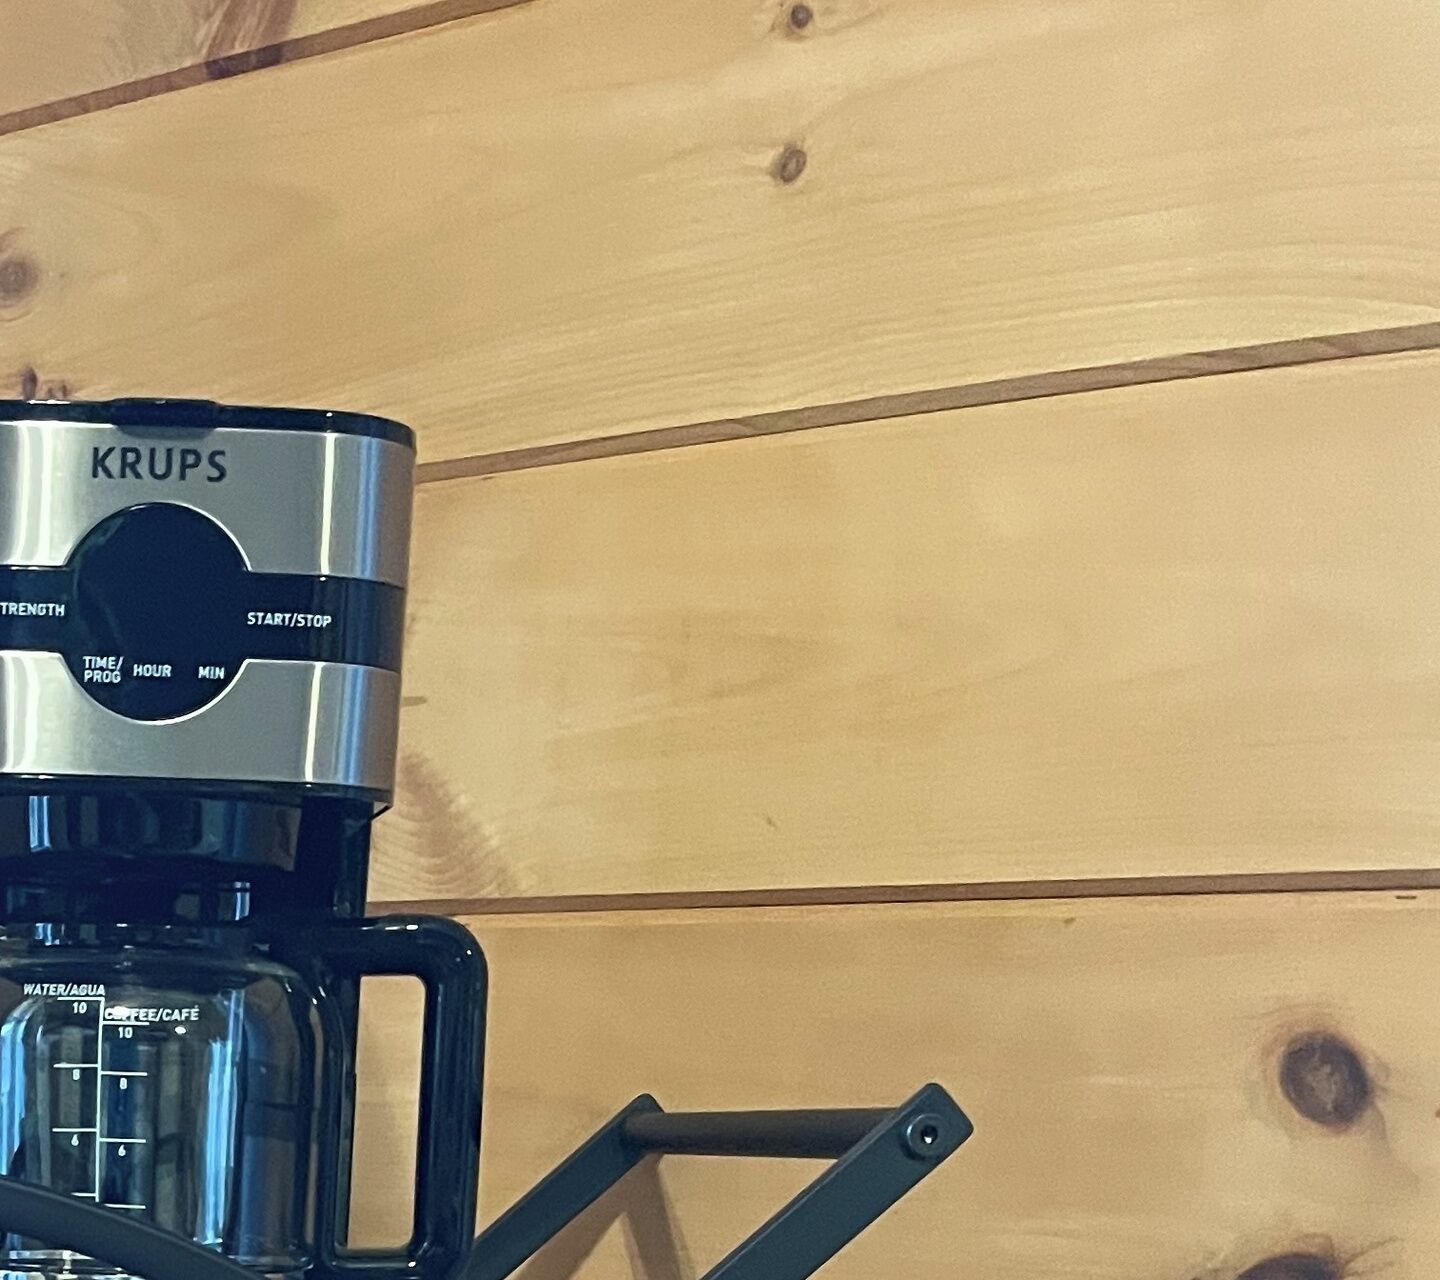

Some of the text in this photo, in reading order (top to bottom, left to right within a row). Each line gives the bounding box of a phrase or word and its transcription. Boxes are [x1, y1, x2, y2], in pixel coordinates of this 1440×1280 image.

[92, 446, 227, 482] KRUPS
[247, 612, 332, 628] START/STOP
[82, 656, 124, 670] TIME/
[83, 669, 121, 683] PROG
[133, 664, 172, 677] HOUR
[198, 666, 225, 679] MIN
[23, 982, 106, 996] WATER/AGUA
[72, 1002, 88, 1014] 10
[118, 1027, 133, 1039] 10
[72, 1069, 80, 1080] 8
[119, 1077, 128, 1090] 8
[71, 1134, 79, 1146] 6
[118, 1144, 126, 1157] 6
